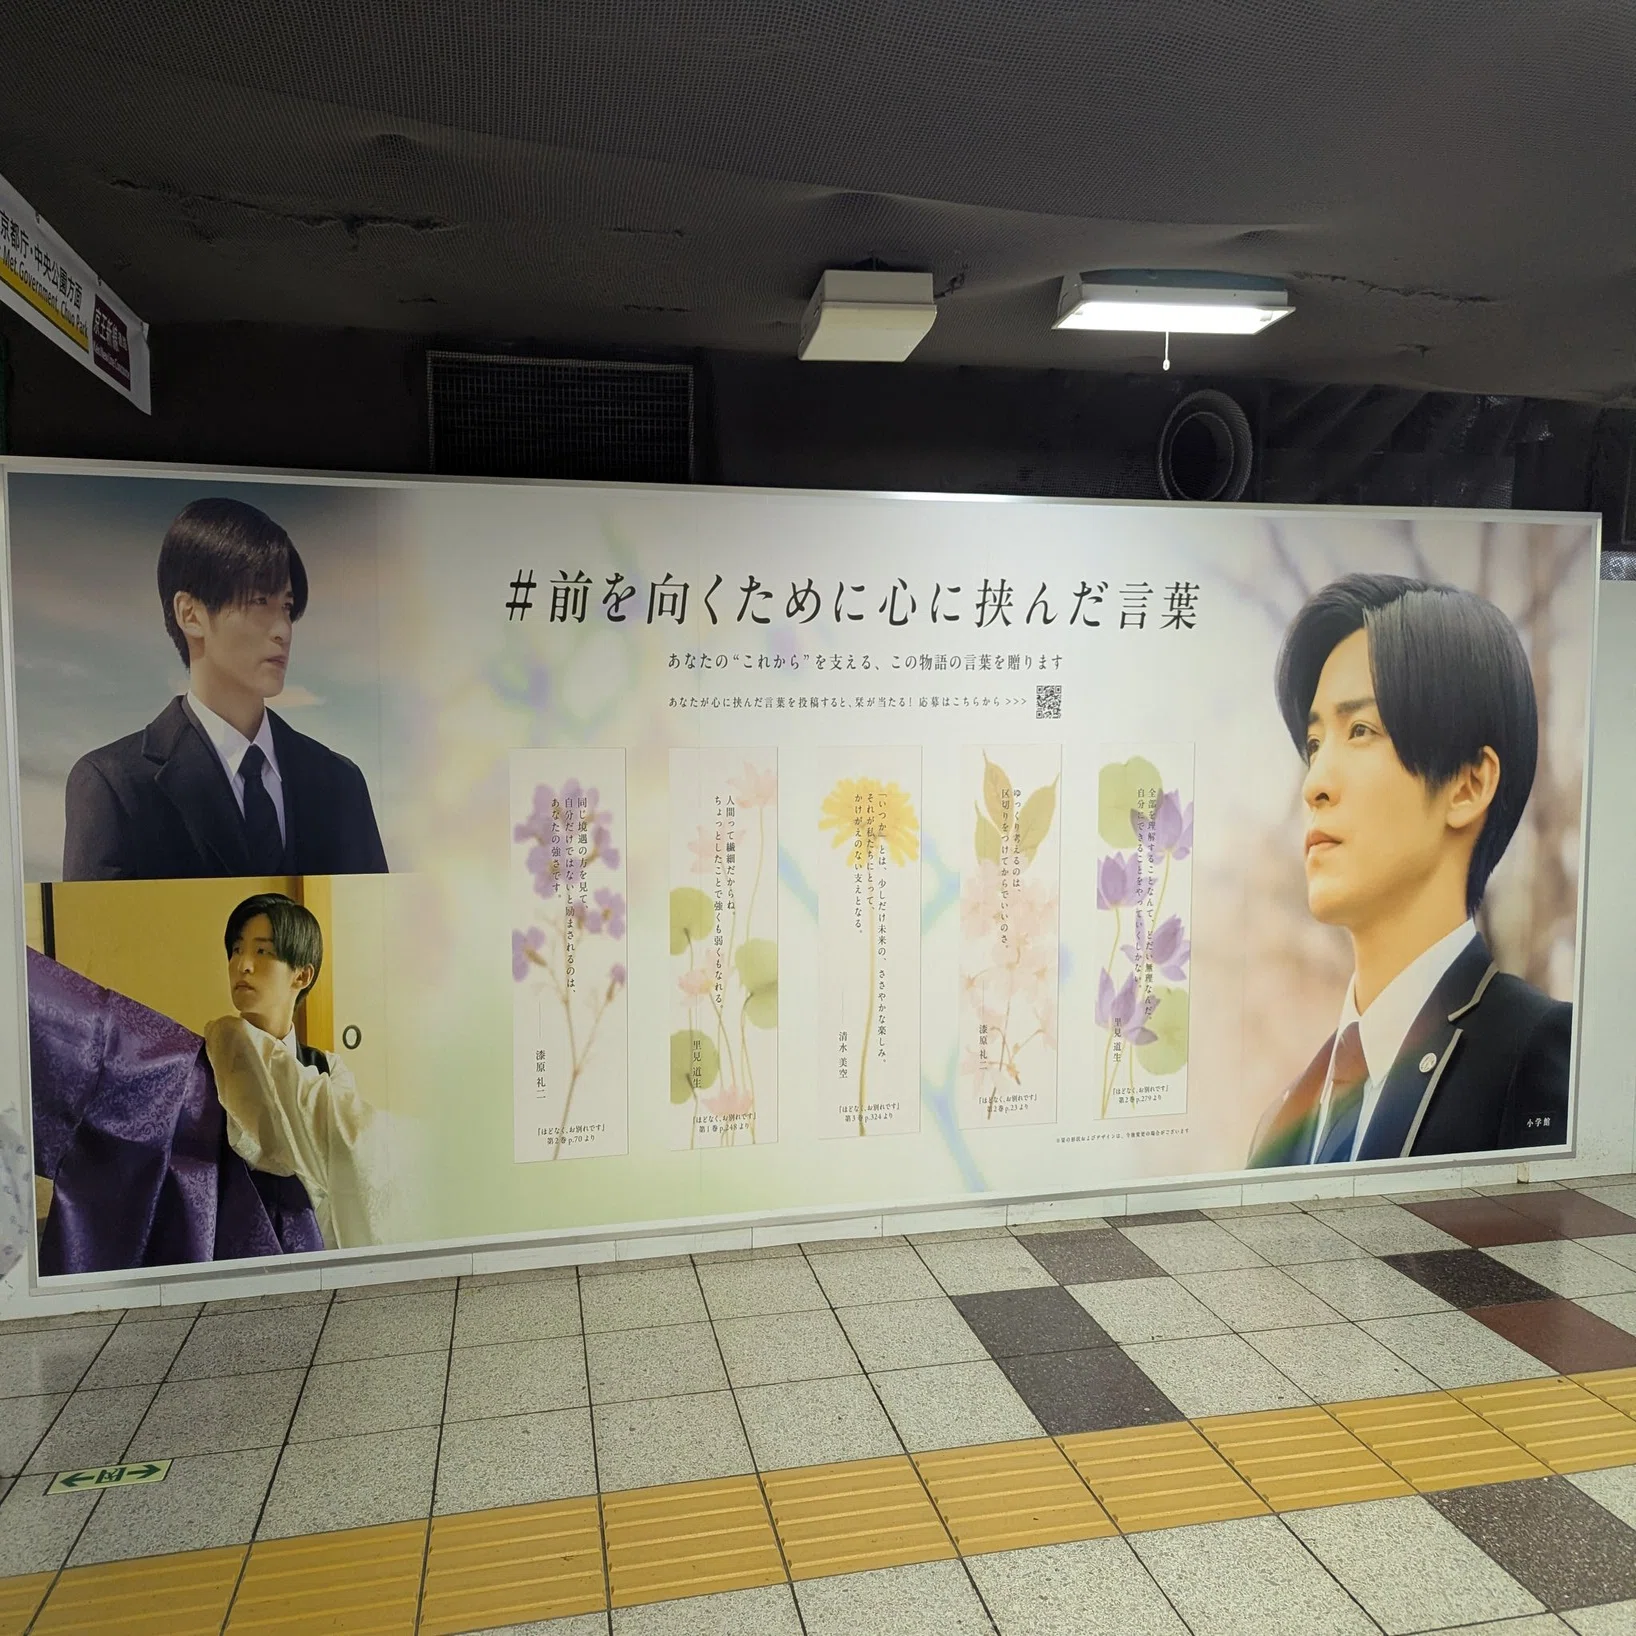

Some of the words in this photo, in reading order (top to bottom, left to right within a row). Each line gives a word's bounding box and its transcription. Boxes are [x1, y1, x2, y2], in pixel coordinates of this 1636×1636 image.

[505, 568, 1201, 630] #前を向くために心に挟んだ言葉
[551, 797, 562, 899] あなたの強さです。
[577, 797, 588, 910] 同じ境遇の方を見て、
[726, 795, 736, 915] 人間って繊細だからね。
[1526, 1116, 1551, 1128] 小学館
